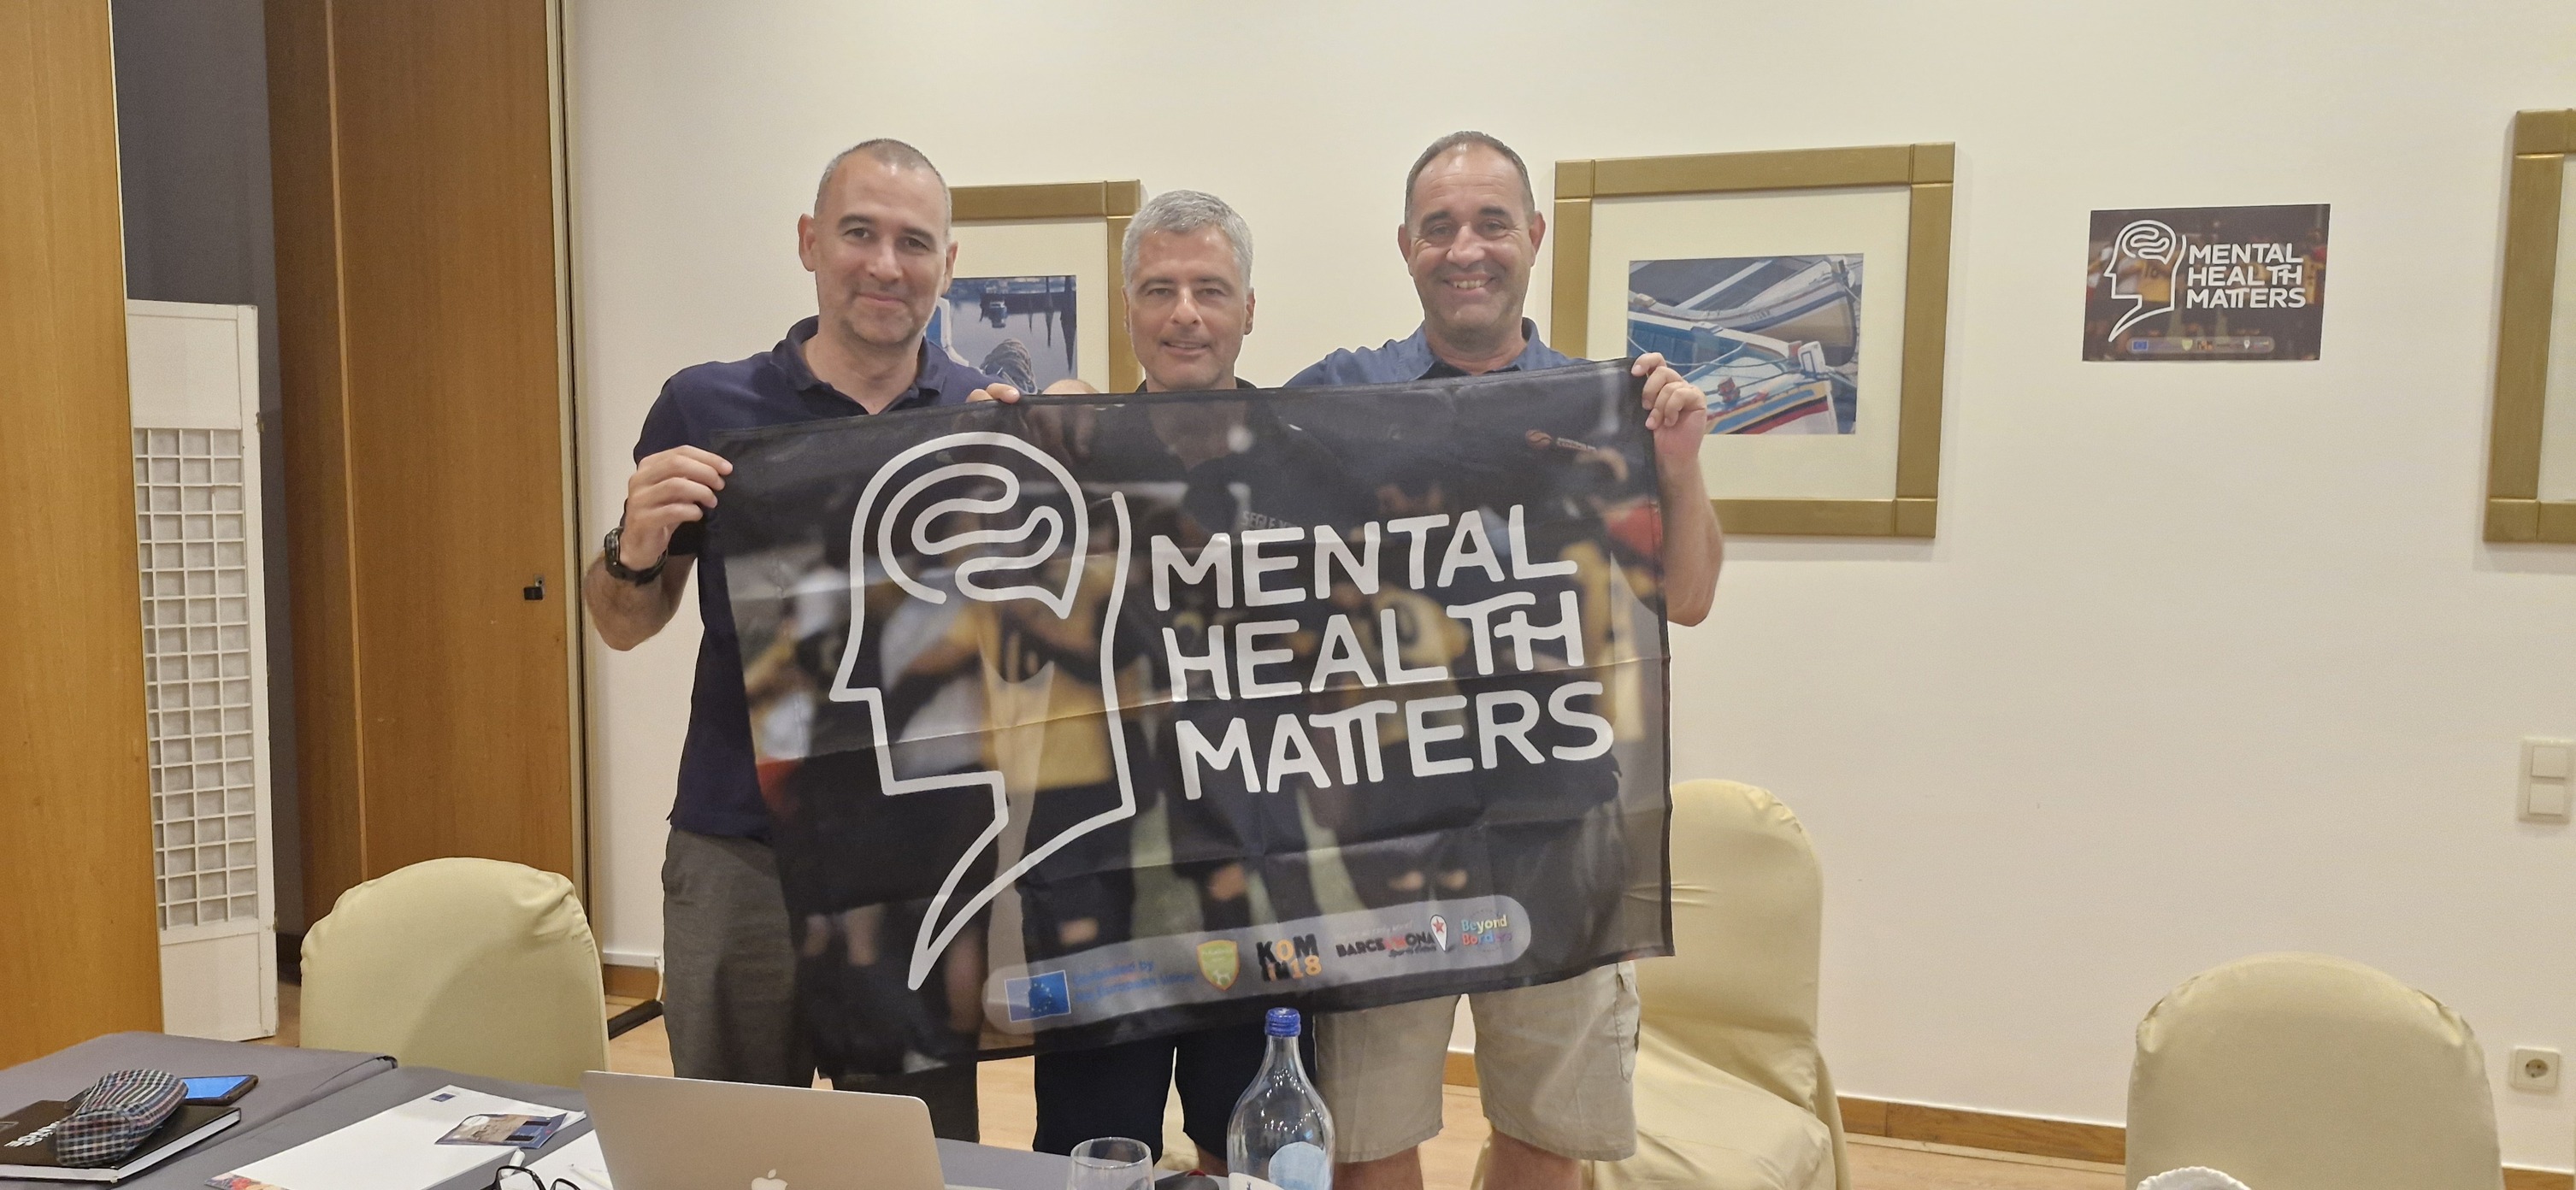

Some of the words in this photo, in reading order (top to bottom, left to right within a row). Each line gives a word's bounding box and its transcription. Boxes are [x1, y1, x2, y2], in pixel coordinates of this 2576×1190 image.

[2189, 243, 2304, 265] MENTAL
[2187, 264, 2302, 287] HEALTH
[2186, 288, 2307, 309] MATTERS
[1151, 504, 1577, 611] MENTAL
[1161, 590, 1584, 702] HEALTH
[1175, 680, 1614, 800] MATTERS
[1461, 915, 1508, 934] Beyond
[1256, 933, 1320, 966] KOM
